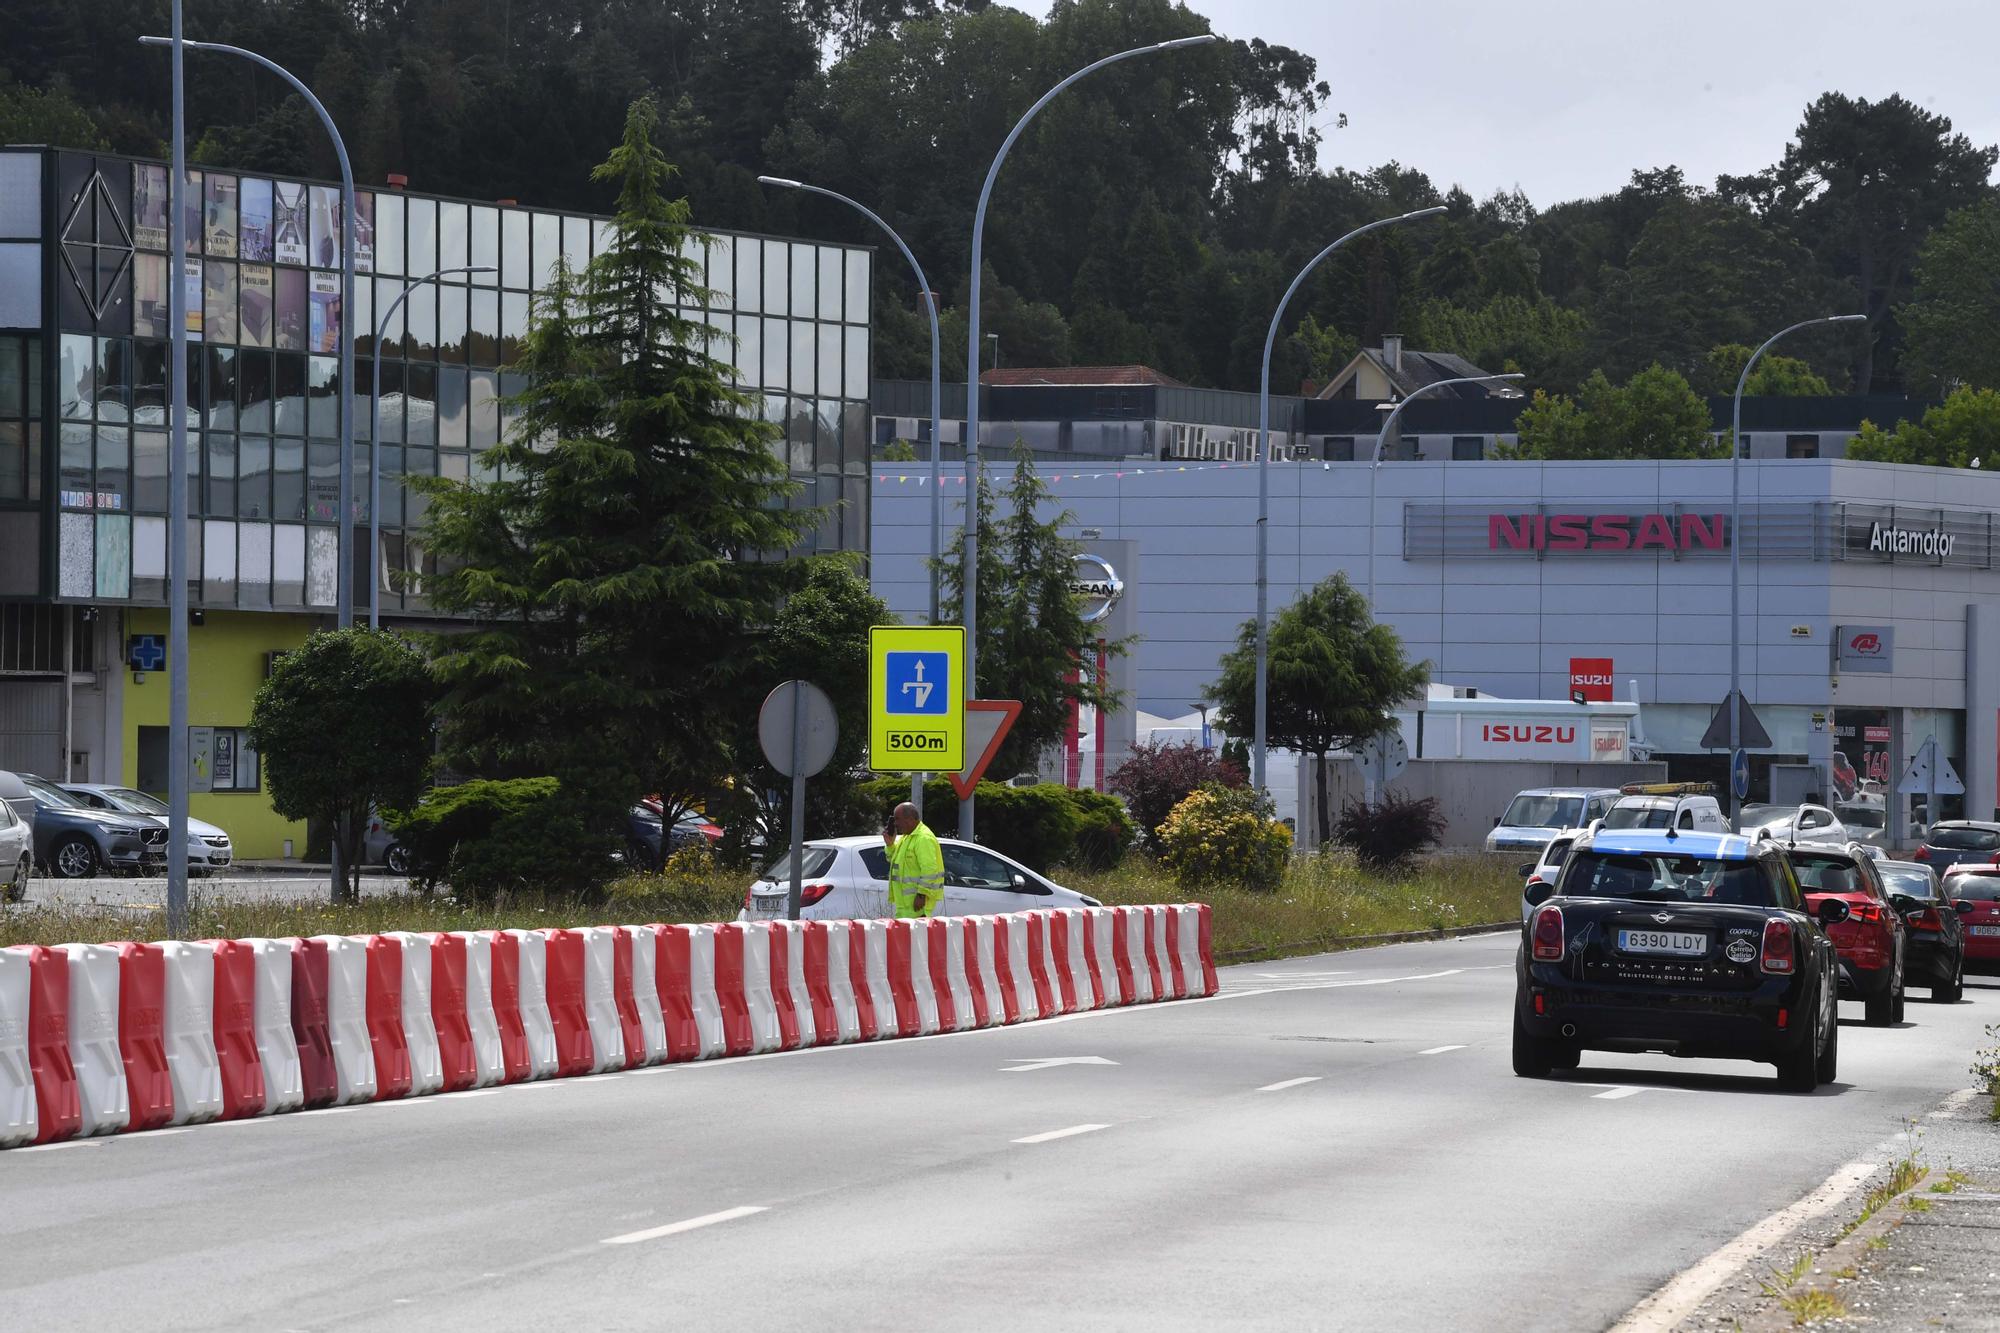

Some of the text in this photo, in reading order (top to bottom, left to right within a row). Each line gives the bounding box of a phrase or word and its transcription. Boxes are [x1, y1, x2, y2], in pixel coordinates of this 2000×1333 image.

[1488, 513, 1724, 550] NISSAN
[1870, 521, 1956, 556] Antamotor
[1571, 674, 1613, 686] ISUZU
[1483, 725, 1575, 743] ISUZU
[890, 734, 944, 749] 500m
[1863, 751, 1890, 782] 140
[1729, 928, 1753, 936] COOPER
[1976, 927, 1998, 935] 9062
[1630, 933, 1702, 950] 6390 LDY
[1730, 945, 1753, 953] Estrella
[1586, 962, 1736, 975] COUNTRYMAN
[1619, 972, 1662, 980] RESISTENCIA
